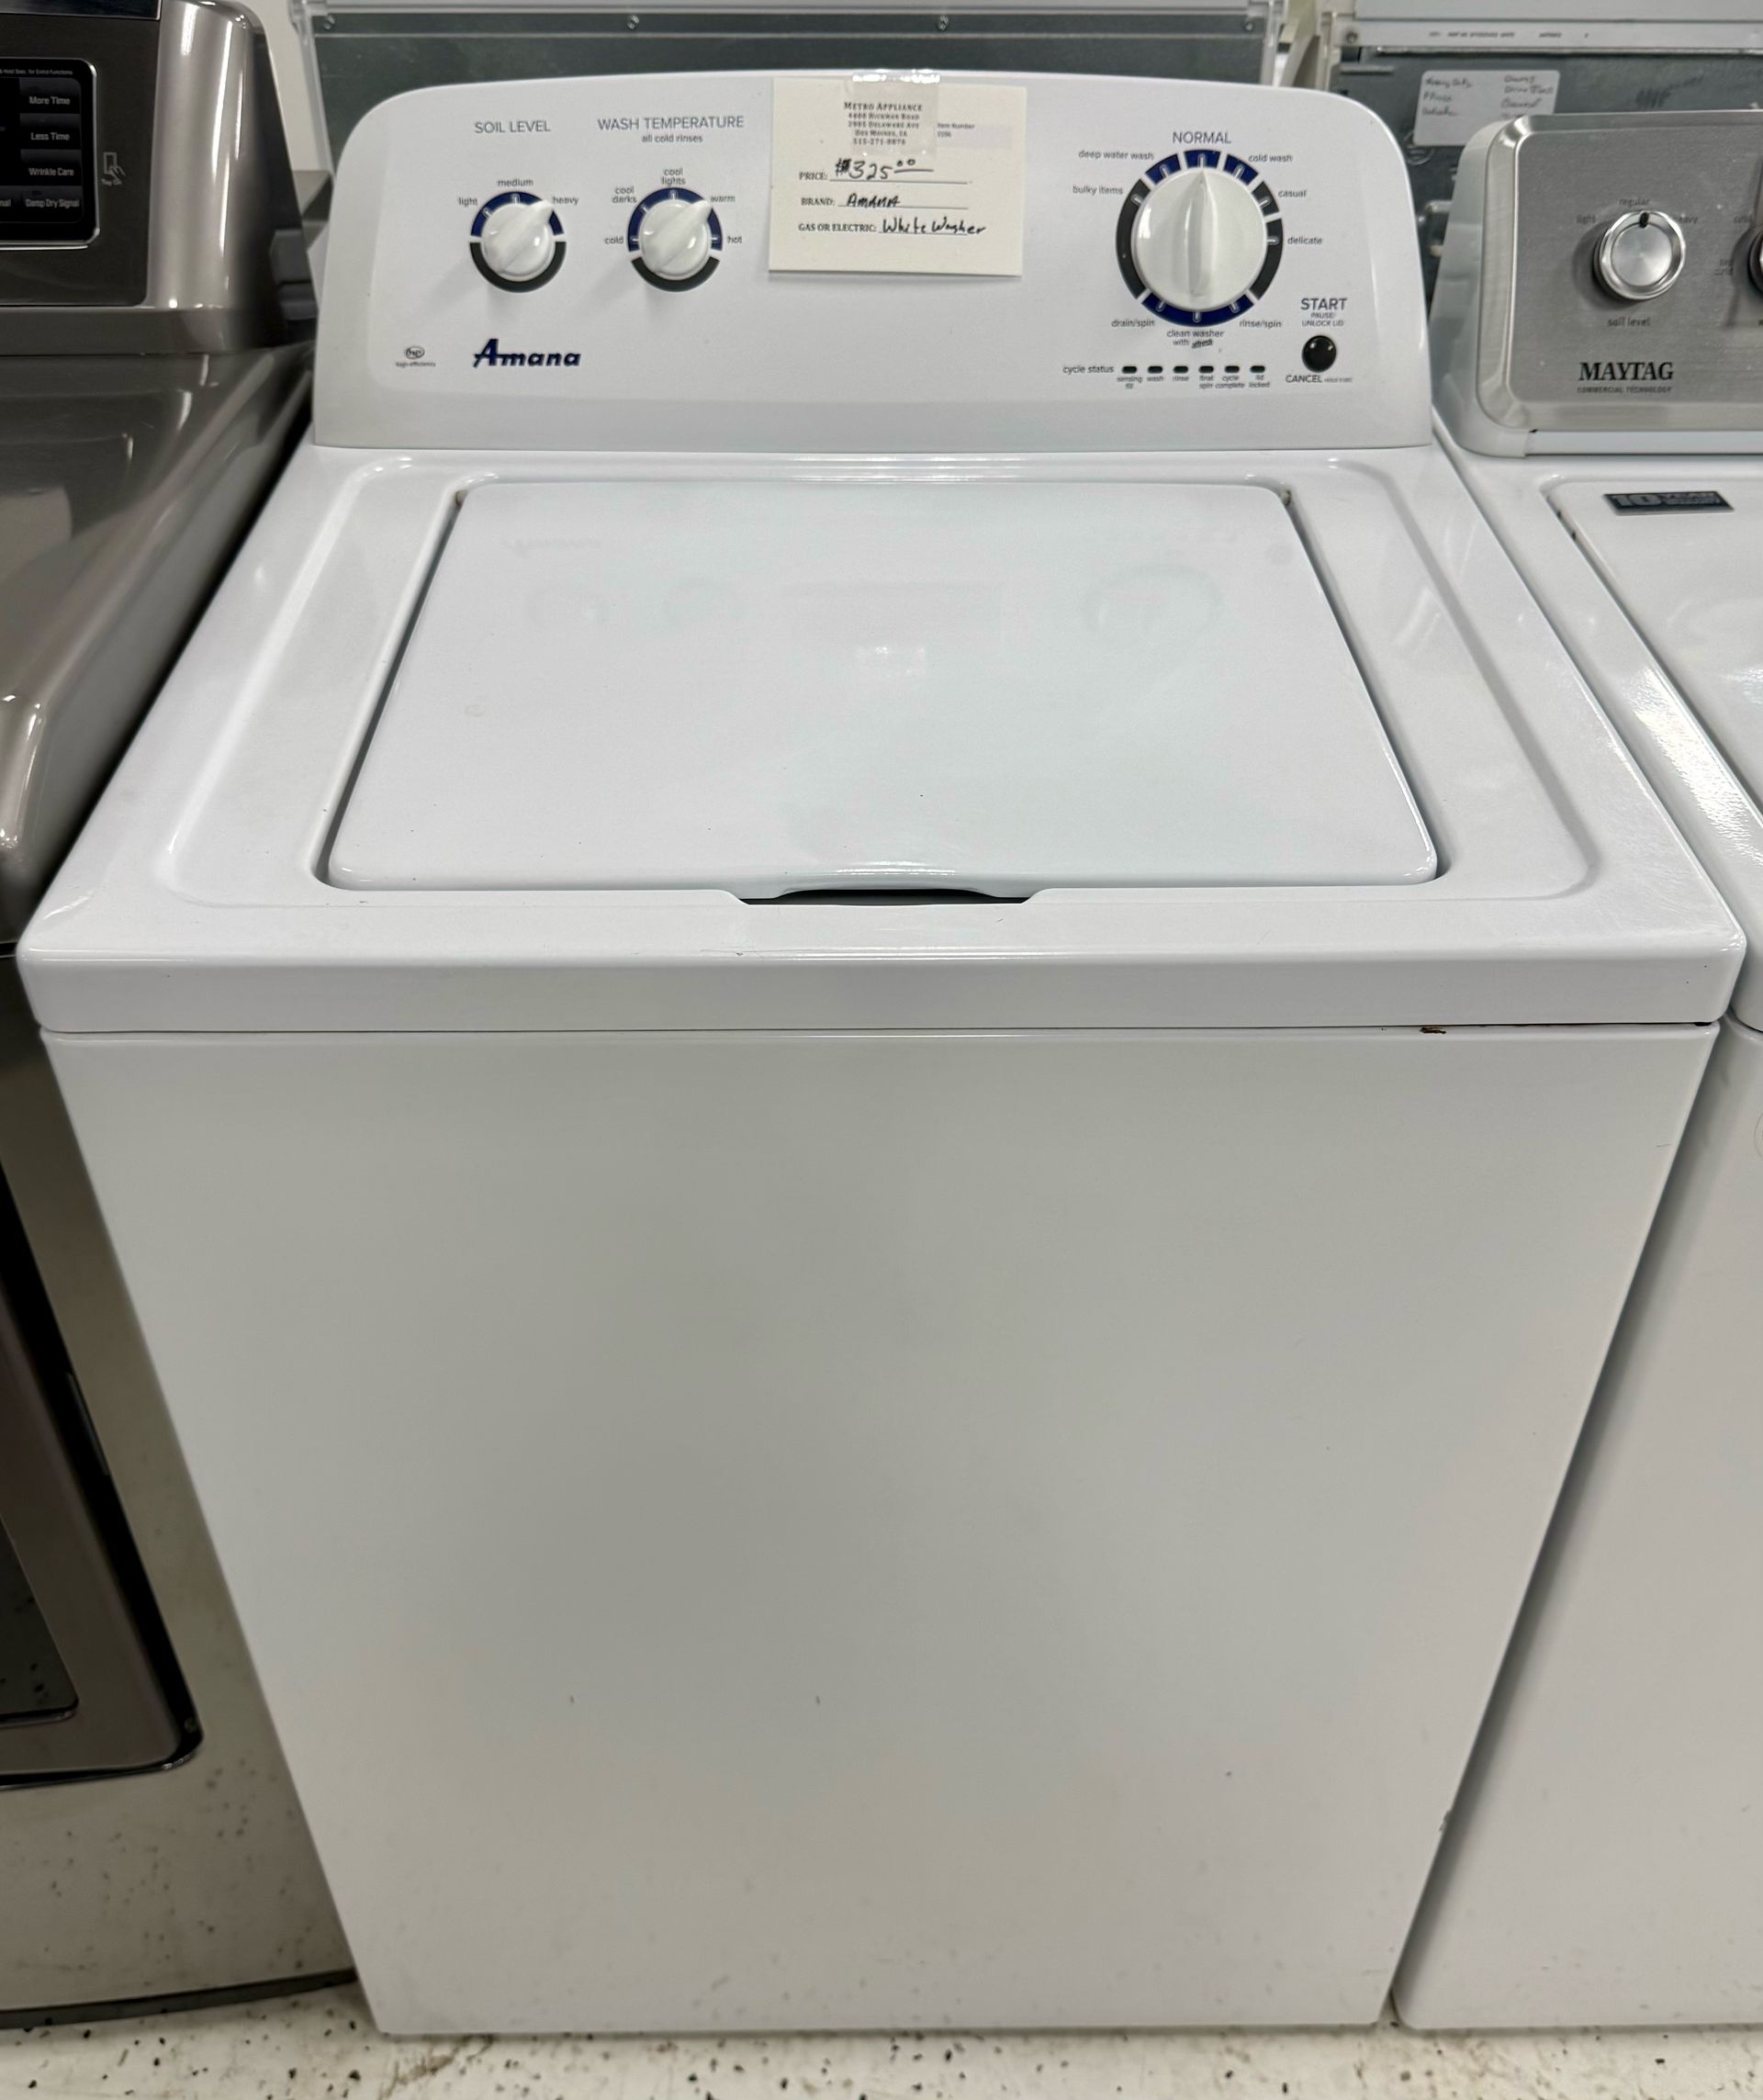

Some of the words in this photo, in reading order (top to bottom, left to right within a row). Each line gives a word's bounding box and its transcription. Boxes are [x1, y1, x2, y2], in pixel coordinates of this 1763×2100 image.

[29, 96, 50, 106] More
[51, 96, 71, 106] Time
[474, 121, 506, 134] SOIL
[509, 120, 551, 133] LEVEL
[597, 118, 640, 130] WASH
[644, 116, 745, 130] TEMPERATURE
[30, 132, 49, 141] Less
[51, 132, 70, 141] Time
[642, 134, 653, 142] all
[655, 134, 674, 142] cold
[676, 134, 703, 142] rinses
[1172, 131, 1231, 144] NORMAL
[1078, 151, 1101, 161] deep
[1103, 152, 1128, 160] water
[1130, 152, 1154, 160] wash
[1248, 154, 1267, 163] cold
[1269, 154, 1293, 163] wash
[28, 167, 56, 176] Wrinkle
[57, 167, 74, 176] Care
[663, 168, 683, 176] cool
[661, 176, 686, 186] lights
[799, 172, 827, 181] PRICE:
[497, 178, 533, 187] medium
[614, 186, 634, 195] cool
[1073, 186, 1096, 196] bulky
[1098, 186, 1123, 195] items
[1278, 189, 1308, 197] casual
[26, 198, 46, 208] Damp
[46, 198, 58, 209] Dry
[59, 198, 80, 208] Signal
[458, 197, 478, 207] light
[553, 196, 579, 207] heavy
[612, 195, 637, 204] darks
[801, 197, 835, 207] BRAND:
[1619, 197, 1650, 208] regular
[1576, 214, 1596, 225] light
[798, 223, 815, 232] GAS
[816, 224, 831, 232] OR
[832, 224, 877, 233] ELECTRIC:
[882, 217, 926, 234] White
[931, 216, 986, 235] Washer
[604, 236, 623, 244] cold
[726, 236, 742, 244] hot
[1287, 236, 1323, 245] delicate
[1300, 298, 1347, 310] START
[1111, 319, 1155, 329] drain/spin
[1240, 320, 1282, 330] rinse/spin
[1608, 317, 1626, 326] soil
[1628, 317, 1651, 326] level
[1167, 330, 1190, 338] clean
[1192, 330, 1225, 338] washer
[473, 339, 581, 368] Amana
[1062, 365, 1084, 376] cycle
[1086, 365, 1114, 374] status
[1578, 362, 1674, 381] MAYTAG
[1117, 376, 1142, 384] sensing
[1221, 375, 1239, 383] cycle
[1286, 376, 1323, 384] CANCEL
[1199, 382, 1214, 390] spin
[1215, 382, 1245, 390] complete
[1625, 386, 1672, 394] TECHNOLOGY
[1611, 494, 1661, 506] 10
